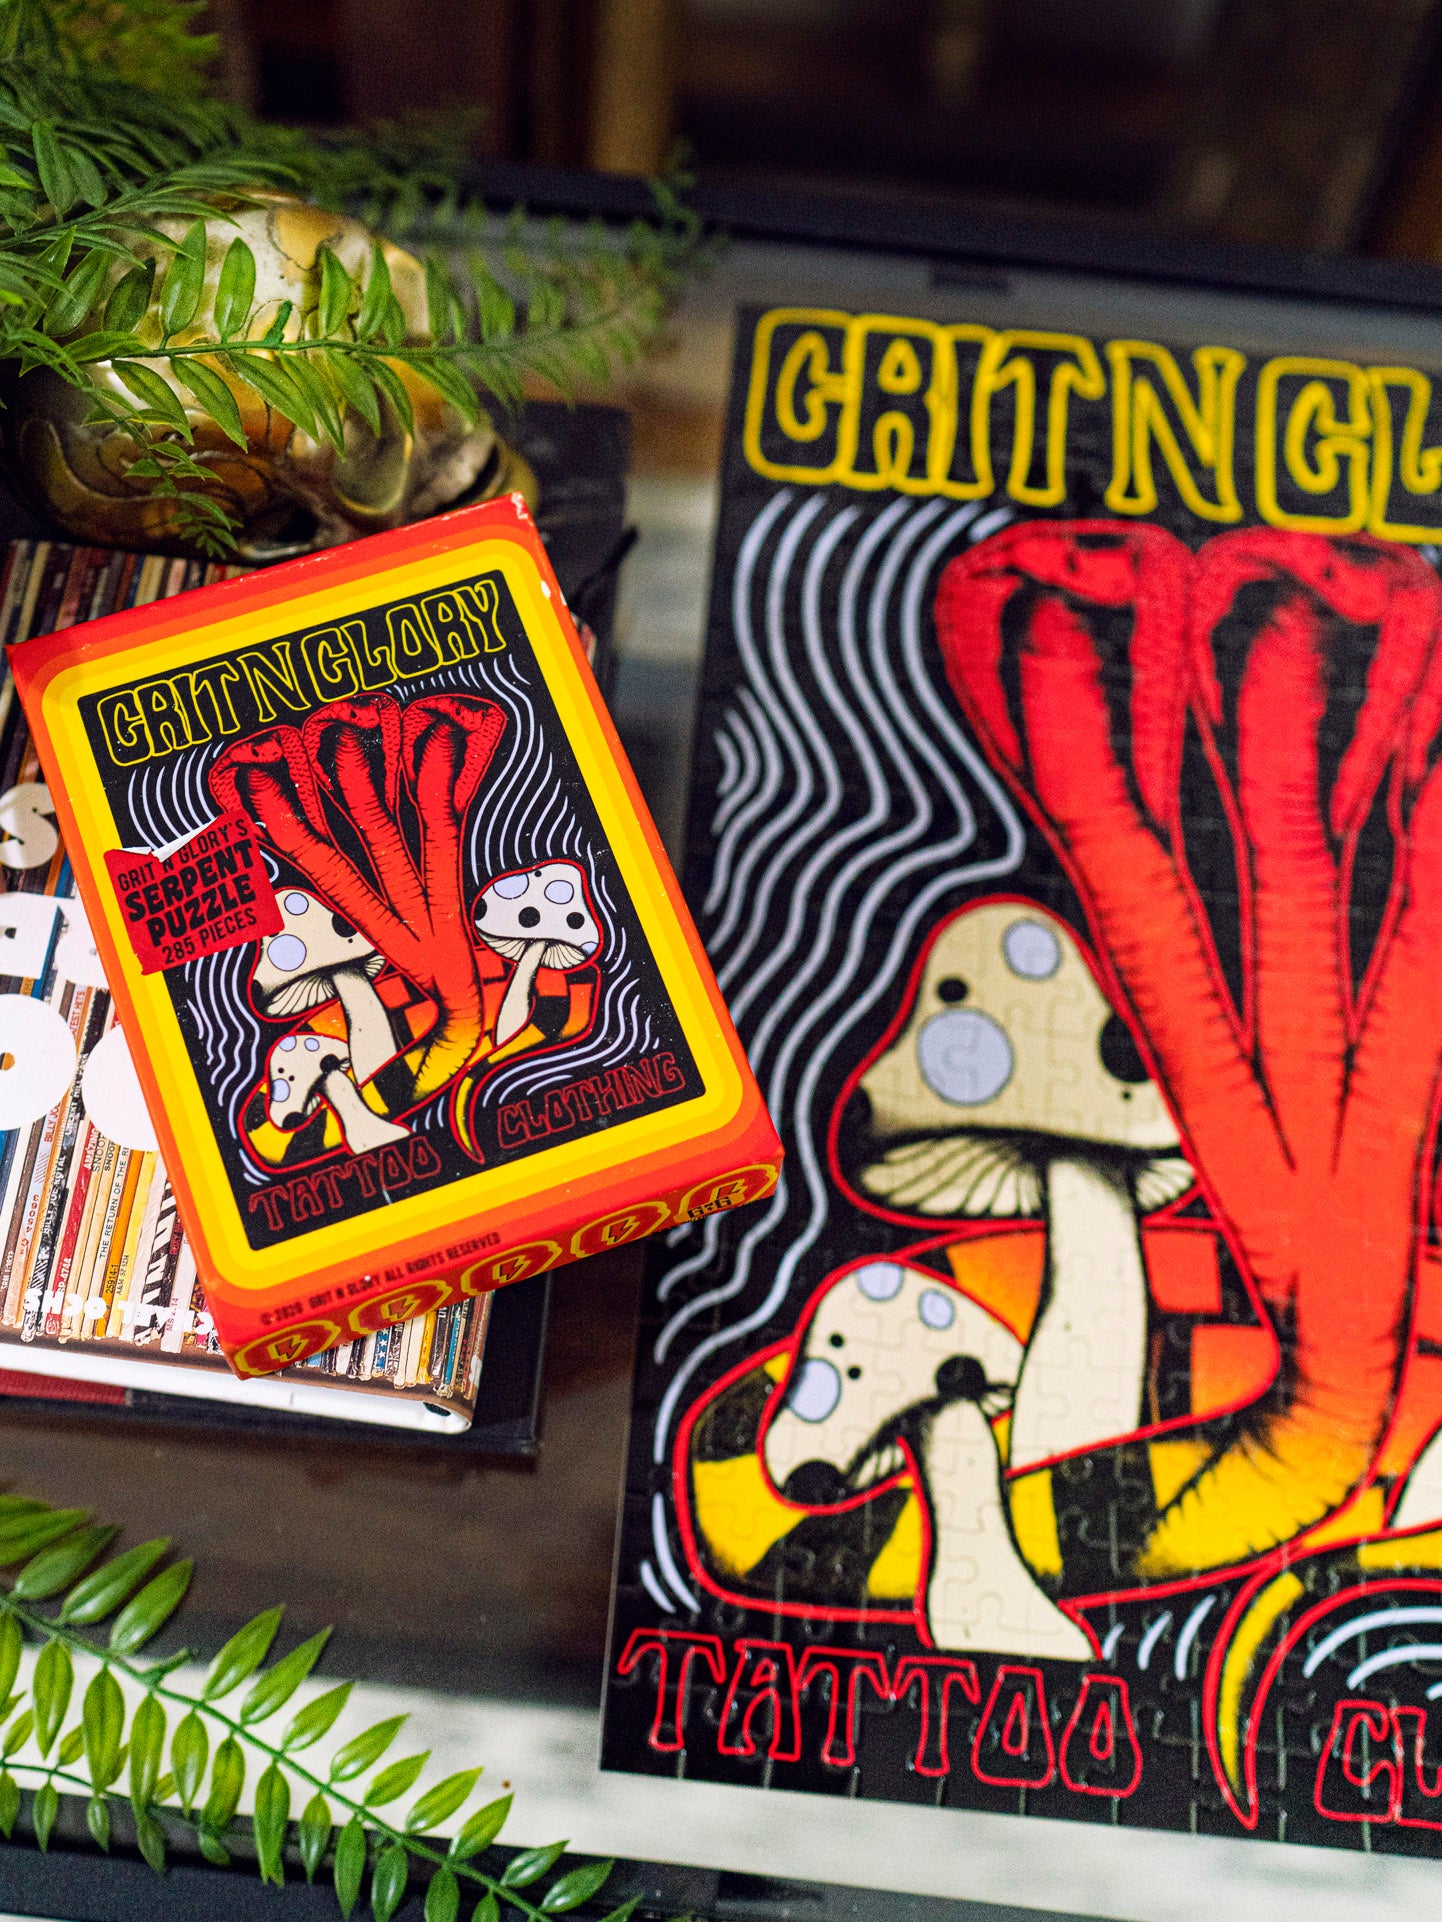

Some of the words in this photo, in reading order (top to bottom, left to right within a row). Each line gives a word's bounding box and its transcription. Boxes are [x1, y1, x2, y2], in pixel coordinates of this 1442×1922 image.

[743, 308, 1105, 507] GRIT
[1105, 338, 1246, 523] N
[97, 661, 241, 768] GRIT
[238, 641, 312, 723] N
[300, 579, 507, 703] GLORY
[117, 861, 155, 892] GRIT
[163, 859, 175, 874] N
[178, 819, 249, 864] GLORY'S
[125, 839, 254, 922] SERPENT
[146, 874, 256, 947] PUZZLE
[162, 936, 195, 965] 285
[200, 908, 257, 948] PIECES
[498, 1052, 685, 1150] CLOTHING
[114, 1183, 122, 1195] OF
[117, 1160, 126, 1178] THE
[248, 1136, 442, 1231] TATTOO
[100, 1240, 110, 1257] THE
[105, 1198, 119, 1240] RETURN
[106, 1264, 119, 1295] 25914-1
[385, 1266, 405, 1283] ALL
[446, 1231, 501, 1260] RESERVED
[617, 1626, 1142, 1798] TATTOO
